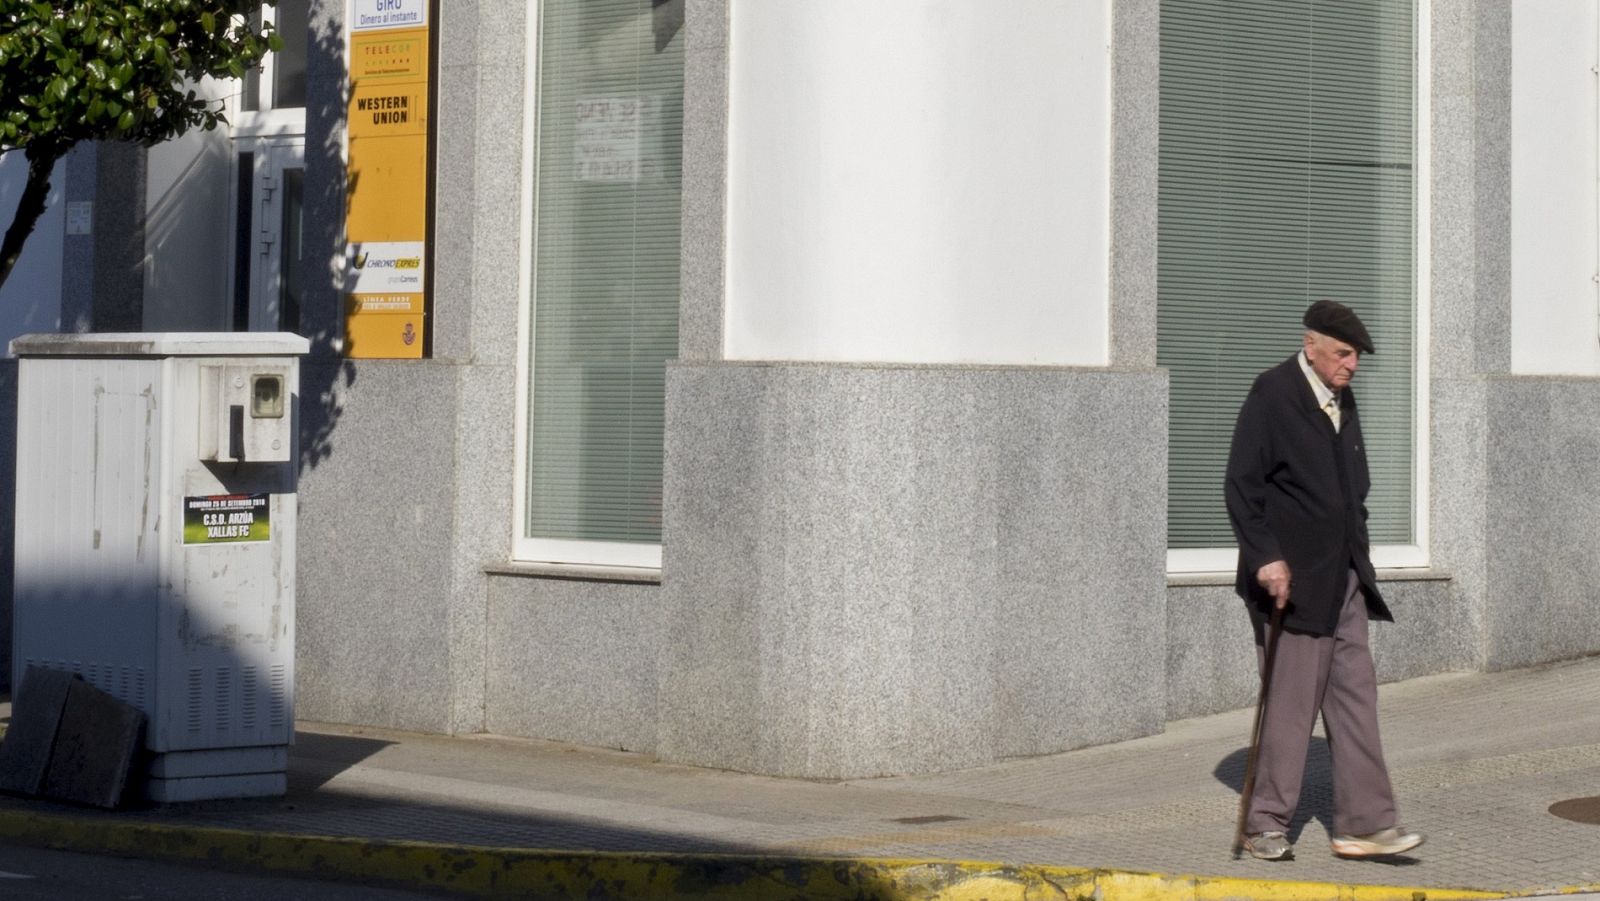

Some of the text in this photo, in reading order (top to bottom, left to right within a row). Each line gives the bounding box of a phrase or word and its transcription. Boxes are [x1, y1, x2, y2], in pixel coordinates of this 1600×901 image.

[376, 0, 402, 11] GIRO
[360, 11, 417, 25] Dinero al instante
[357, 96, 408, 111] WESTERN
[373, 111, 408, 125] UNION
[203, 511, 254, 526] C.S.D. ARZÚA
[208, 525, 249, 538] XALLAS FC
